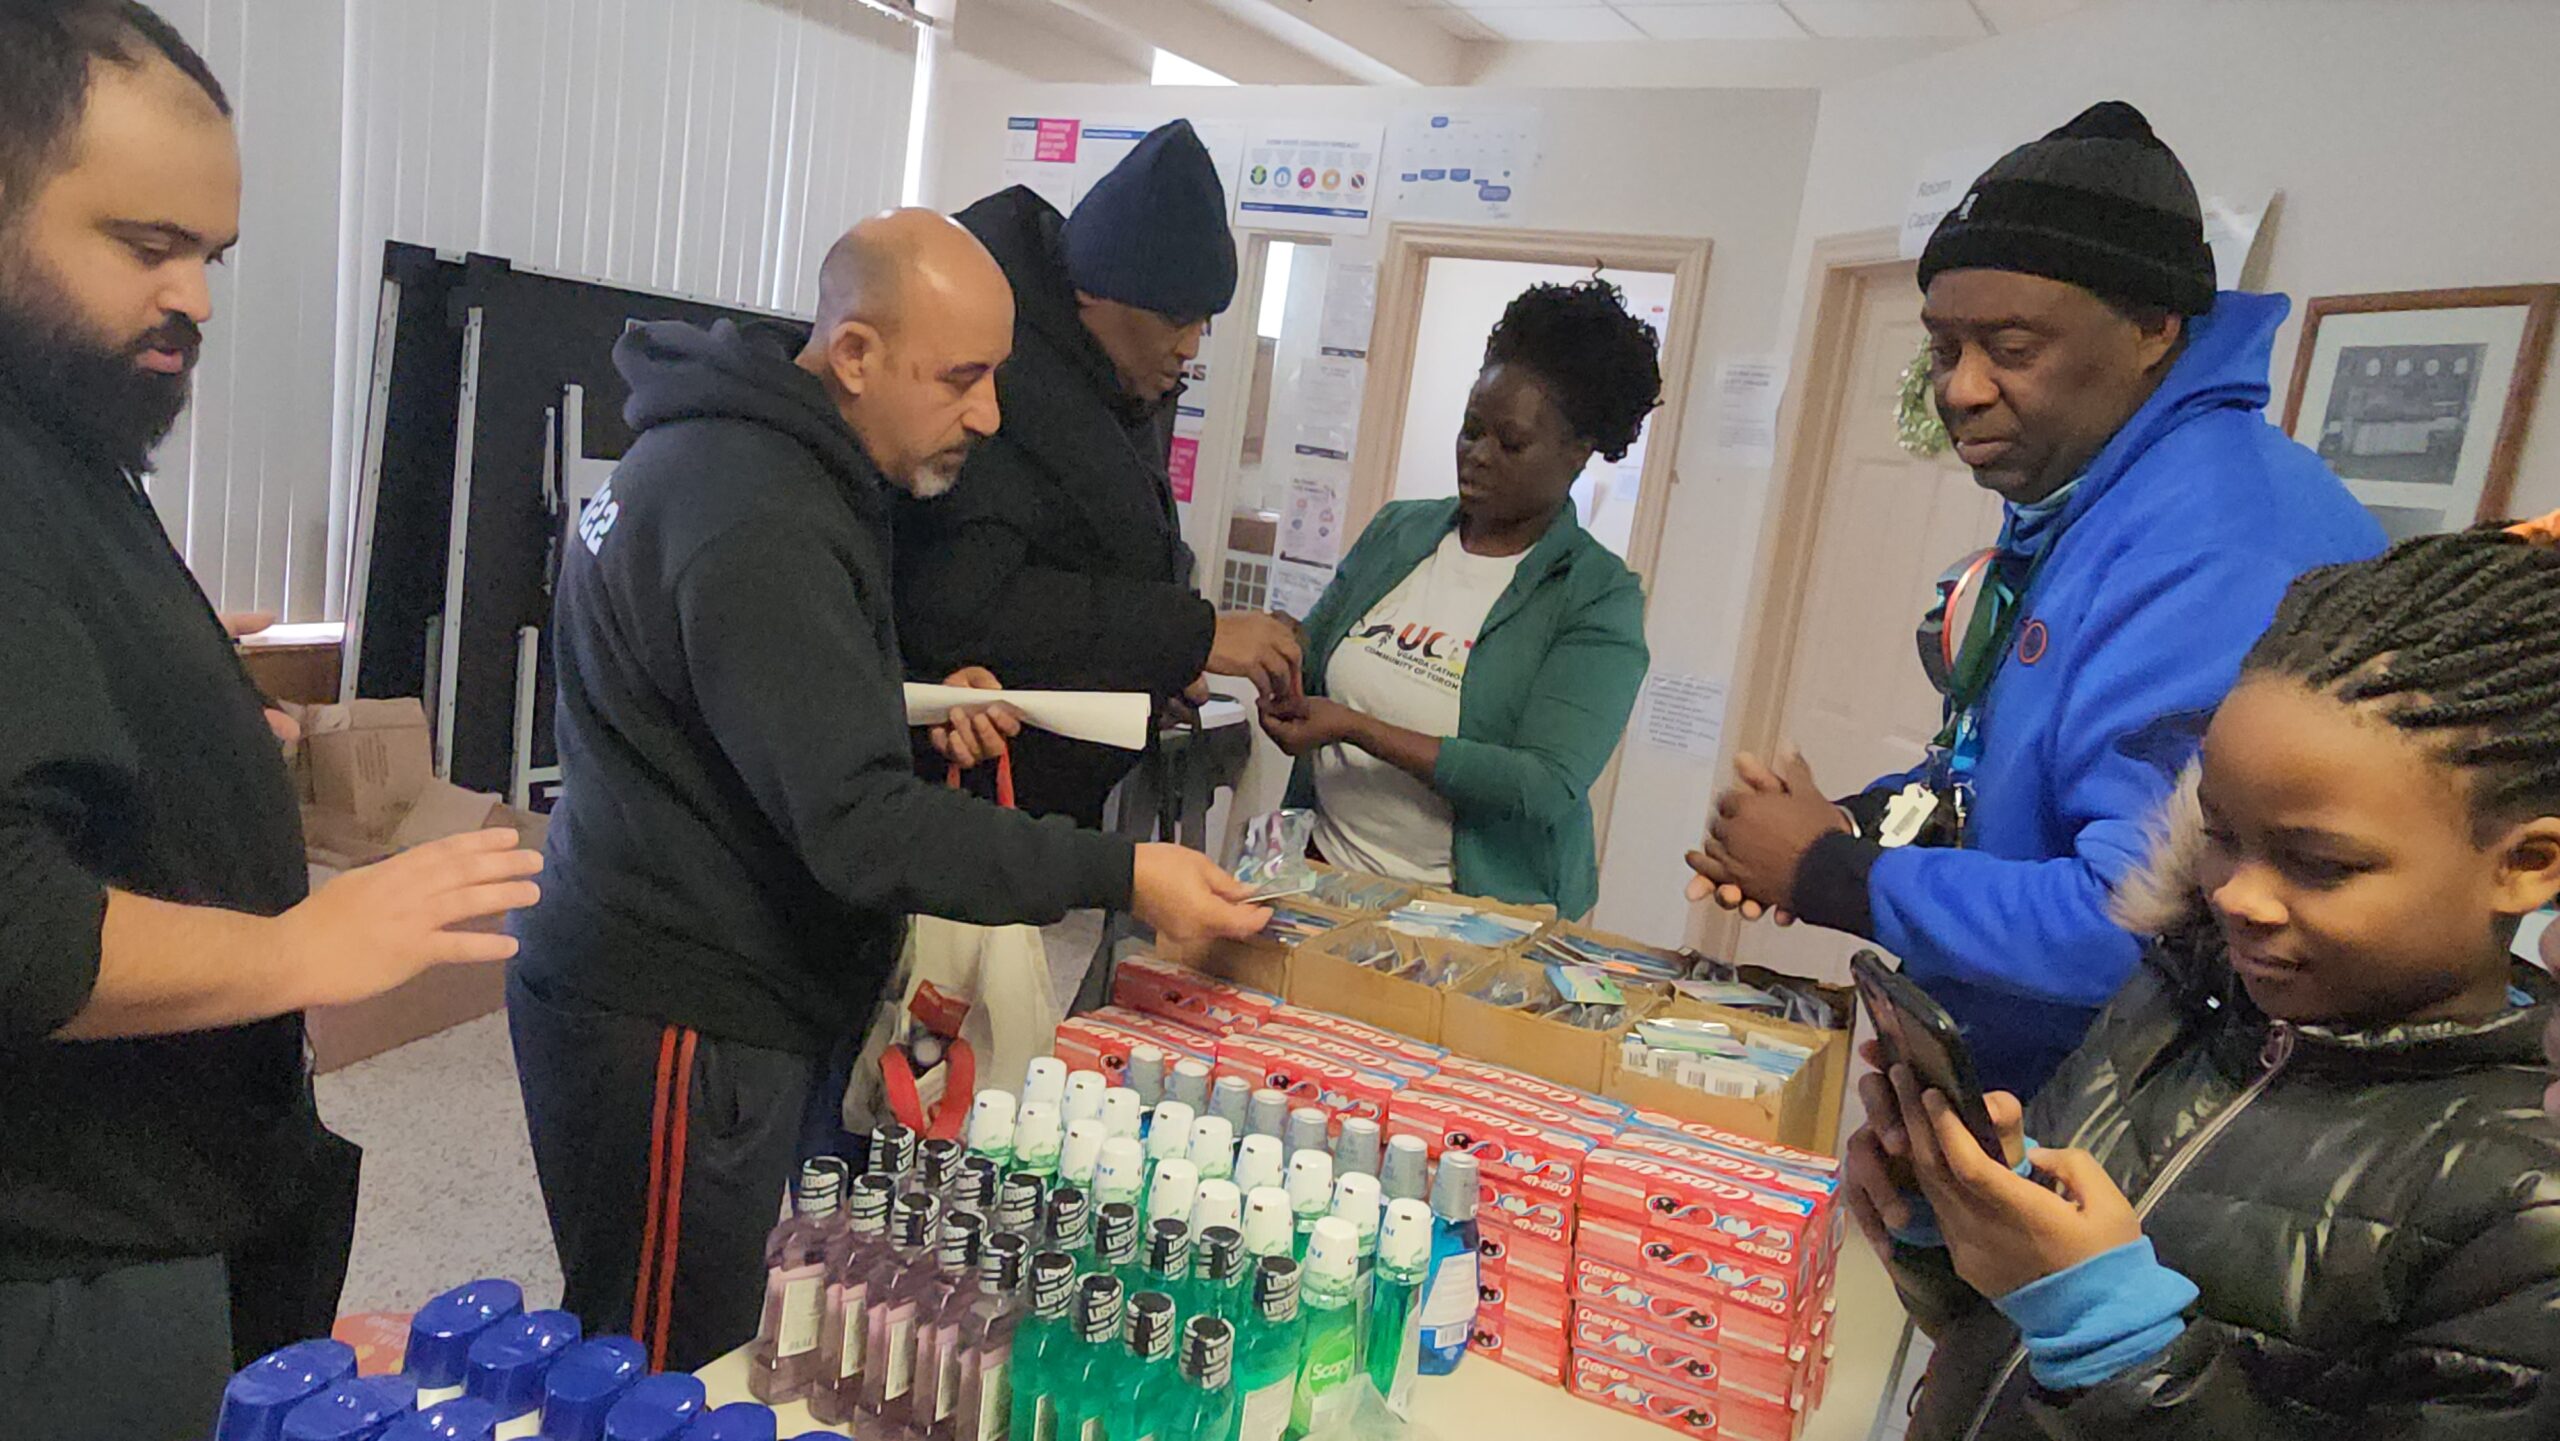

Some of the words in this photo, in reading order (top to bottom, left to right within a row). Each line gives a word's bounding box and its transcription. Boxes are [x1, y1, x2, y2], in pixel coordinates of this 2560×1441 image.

[579, 475, 620, 556] 22
[1364, 645, 1414, 670] COMMUNITY
[1414, 666, 1427, 675] OF
[1397, 650, 1429, 668] UGANDA
